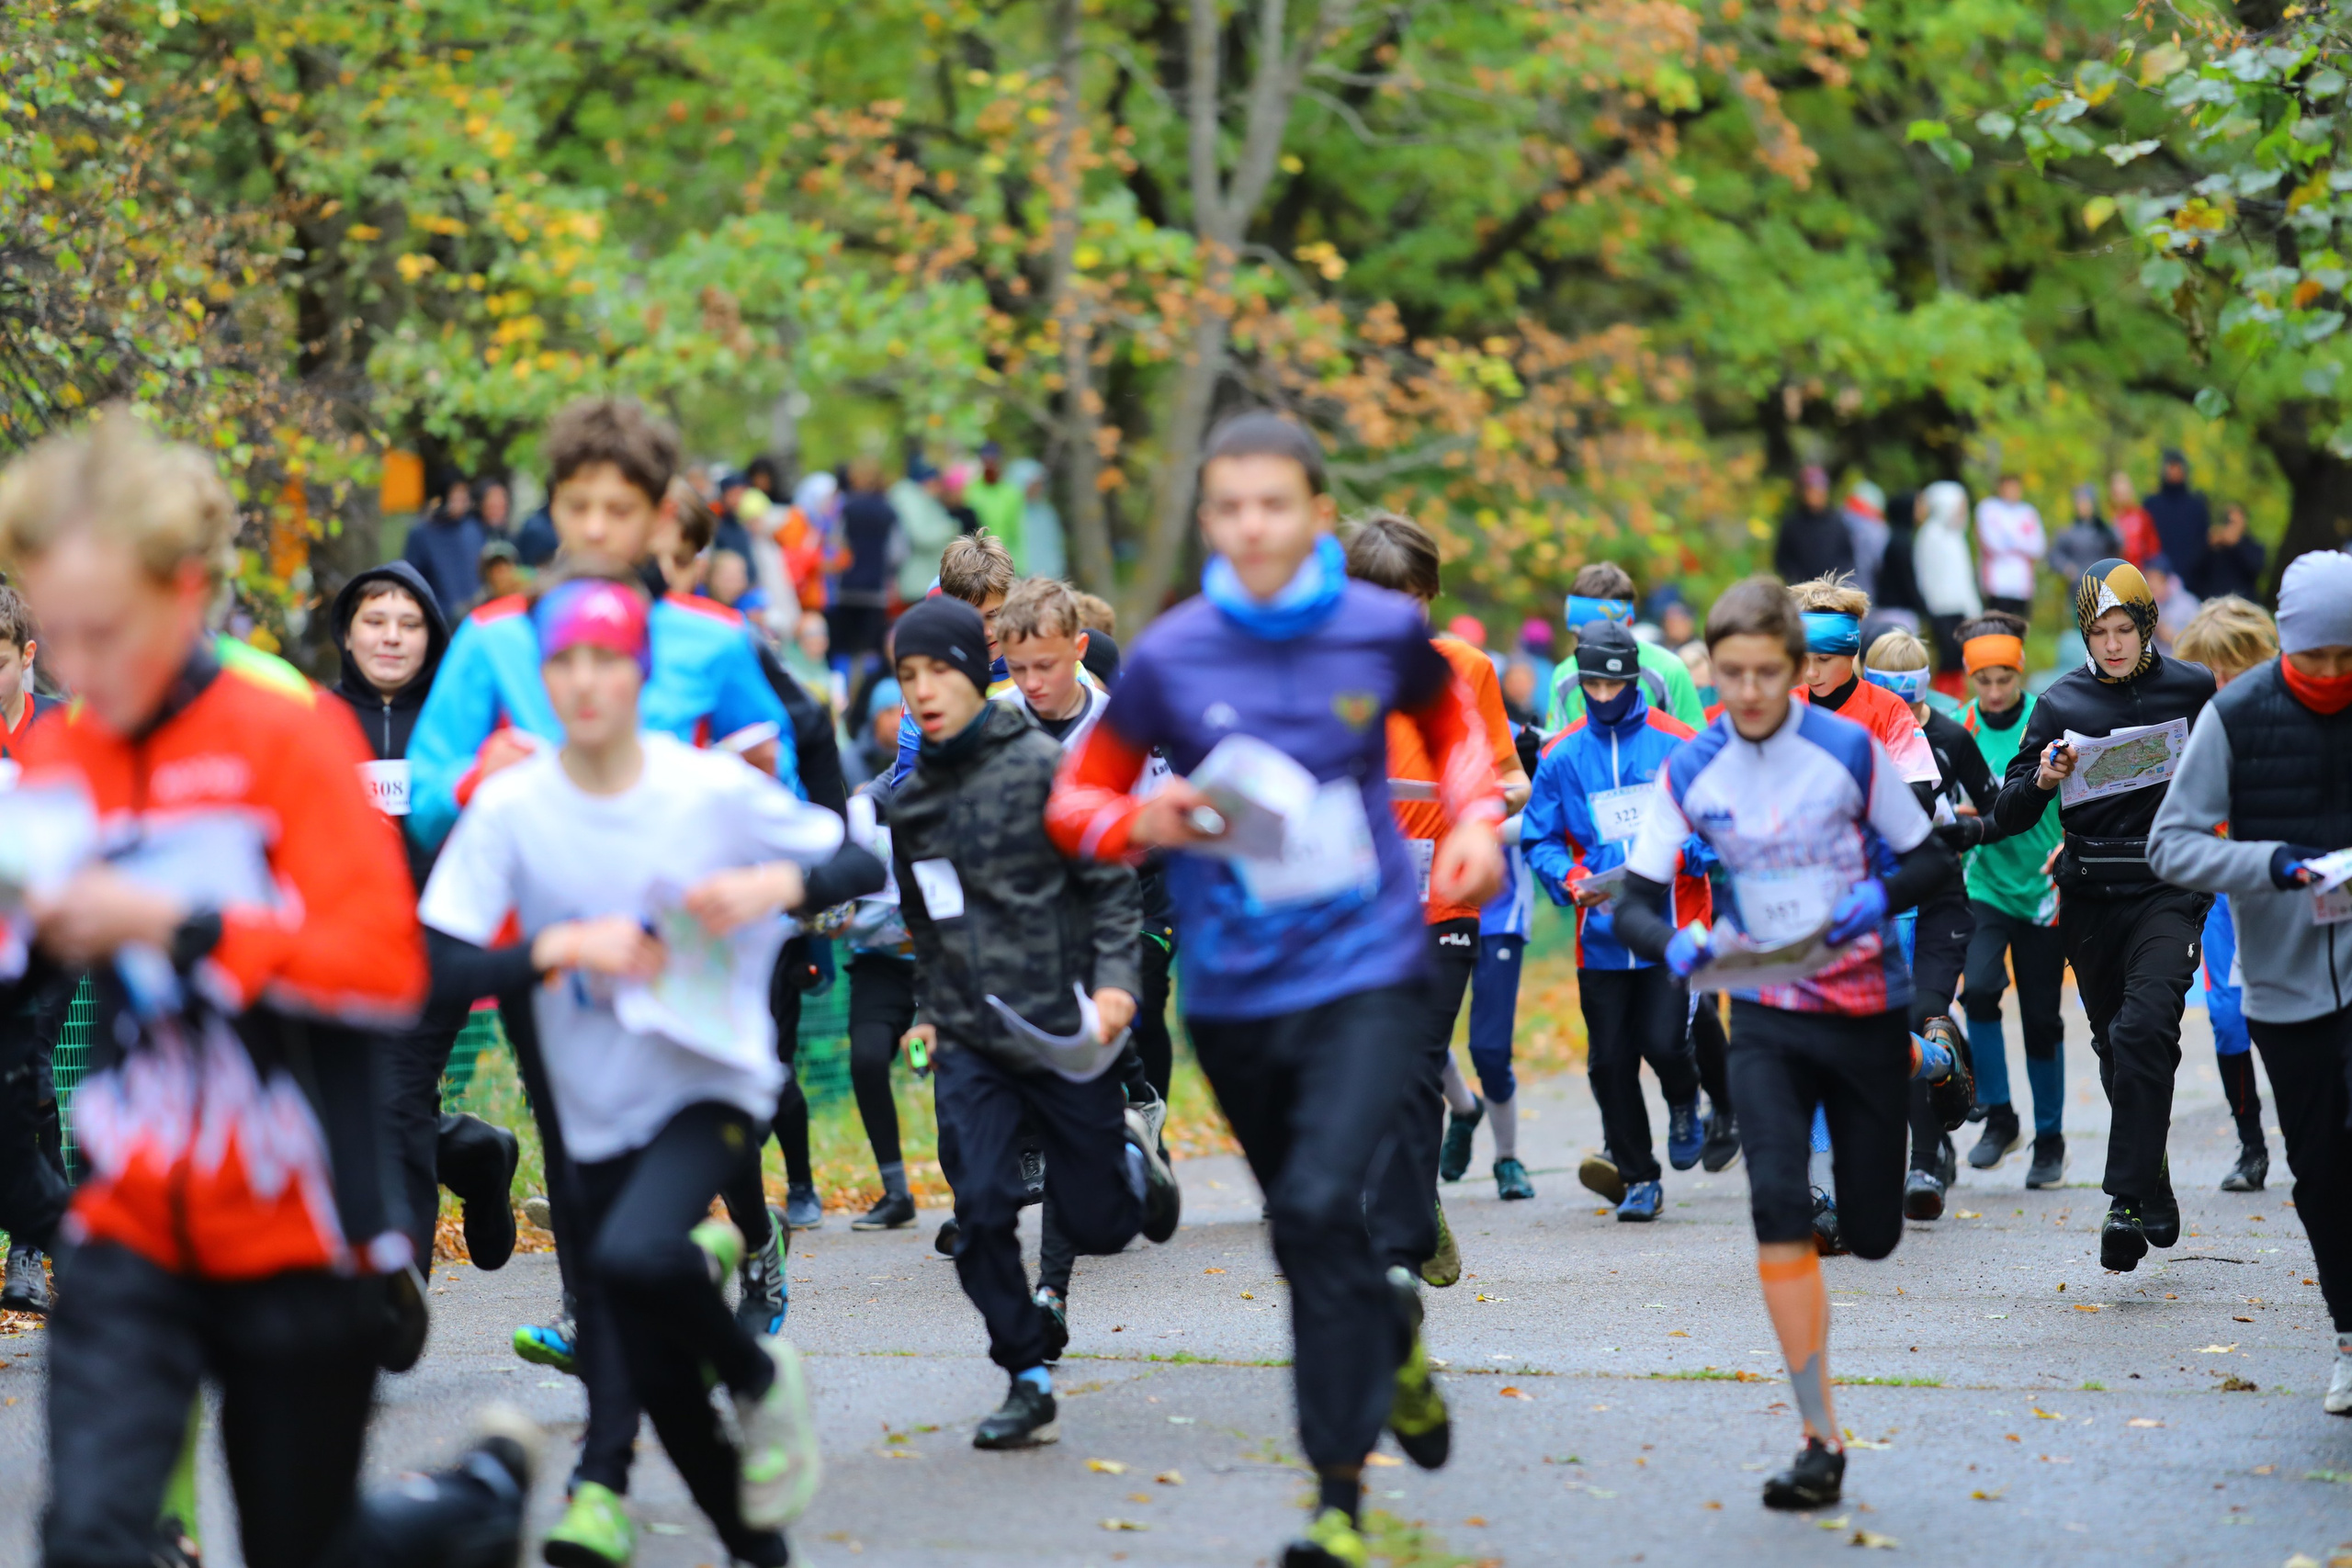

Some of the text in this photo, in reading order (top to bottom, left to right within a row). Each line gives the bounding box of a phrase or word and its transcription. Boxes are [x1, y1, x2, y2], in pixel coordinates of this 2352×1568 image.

[368, 781, 403, 797] 308
[1614, 807, 1638, 825] 322
[1439, 932, 1471, 947] FILA
